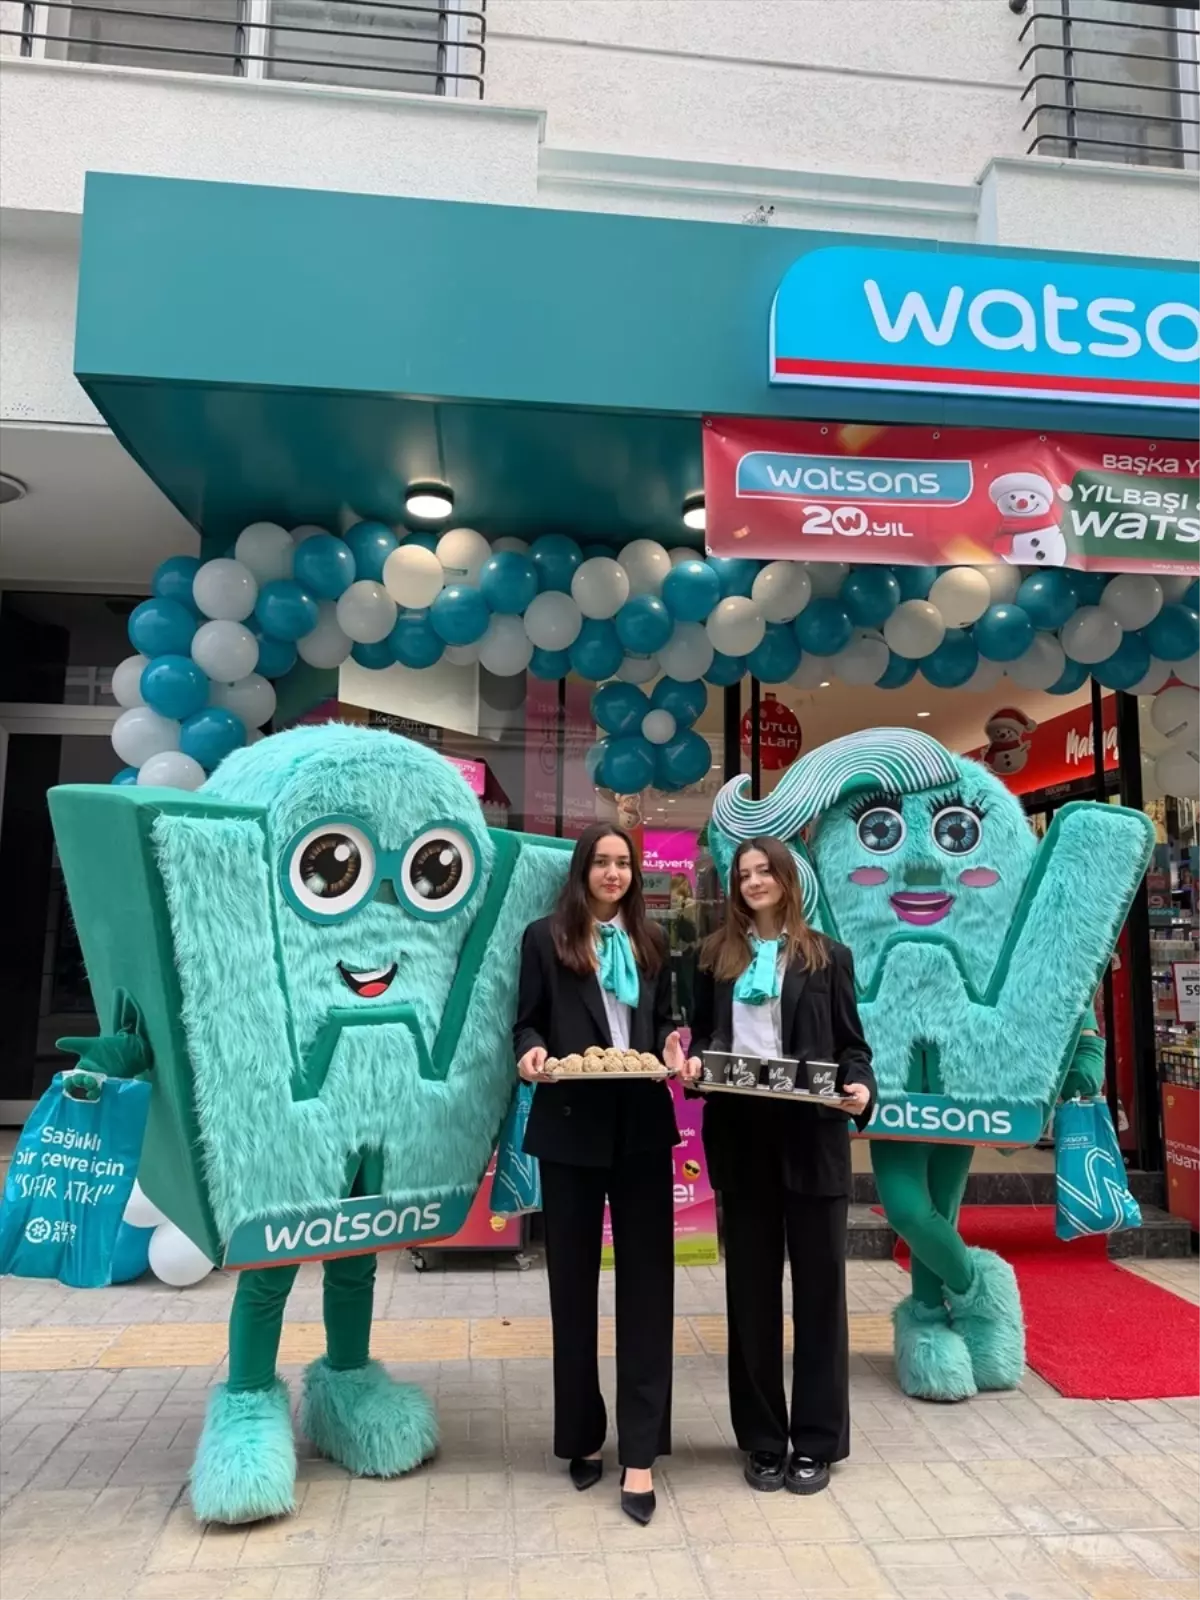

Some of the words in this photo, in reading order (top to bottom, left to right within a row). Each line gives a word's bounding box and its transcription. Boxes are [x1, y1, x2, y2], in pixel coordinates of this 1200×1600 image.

[766, 464, 941, 495] watsons
[41, 1152, 89, 1174] çevre
[90, 1157, 125, 1178] için
[264, 1202, 442, 1253] watsons
